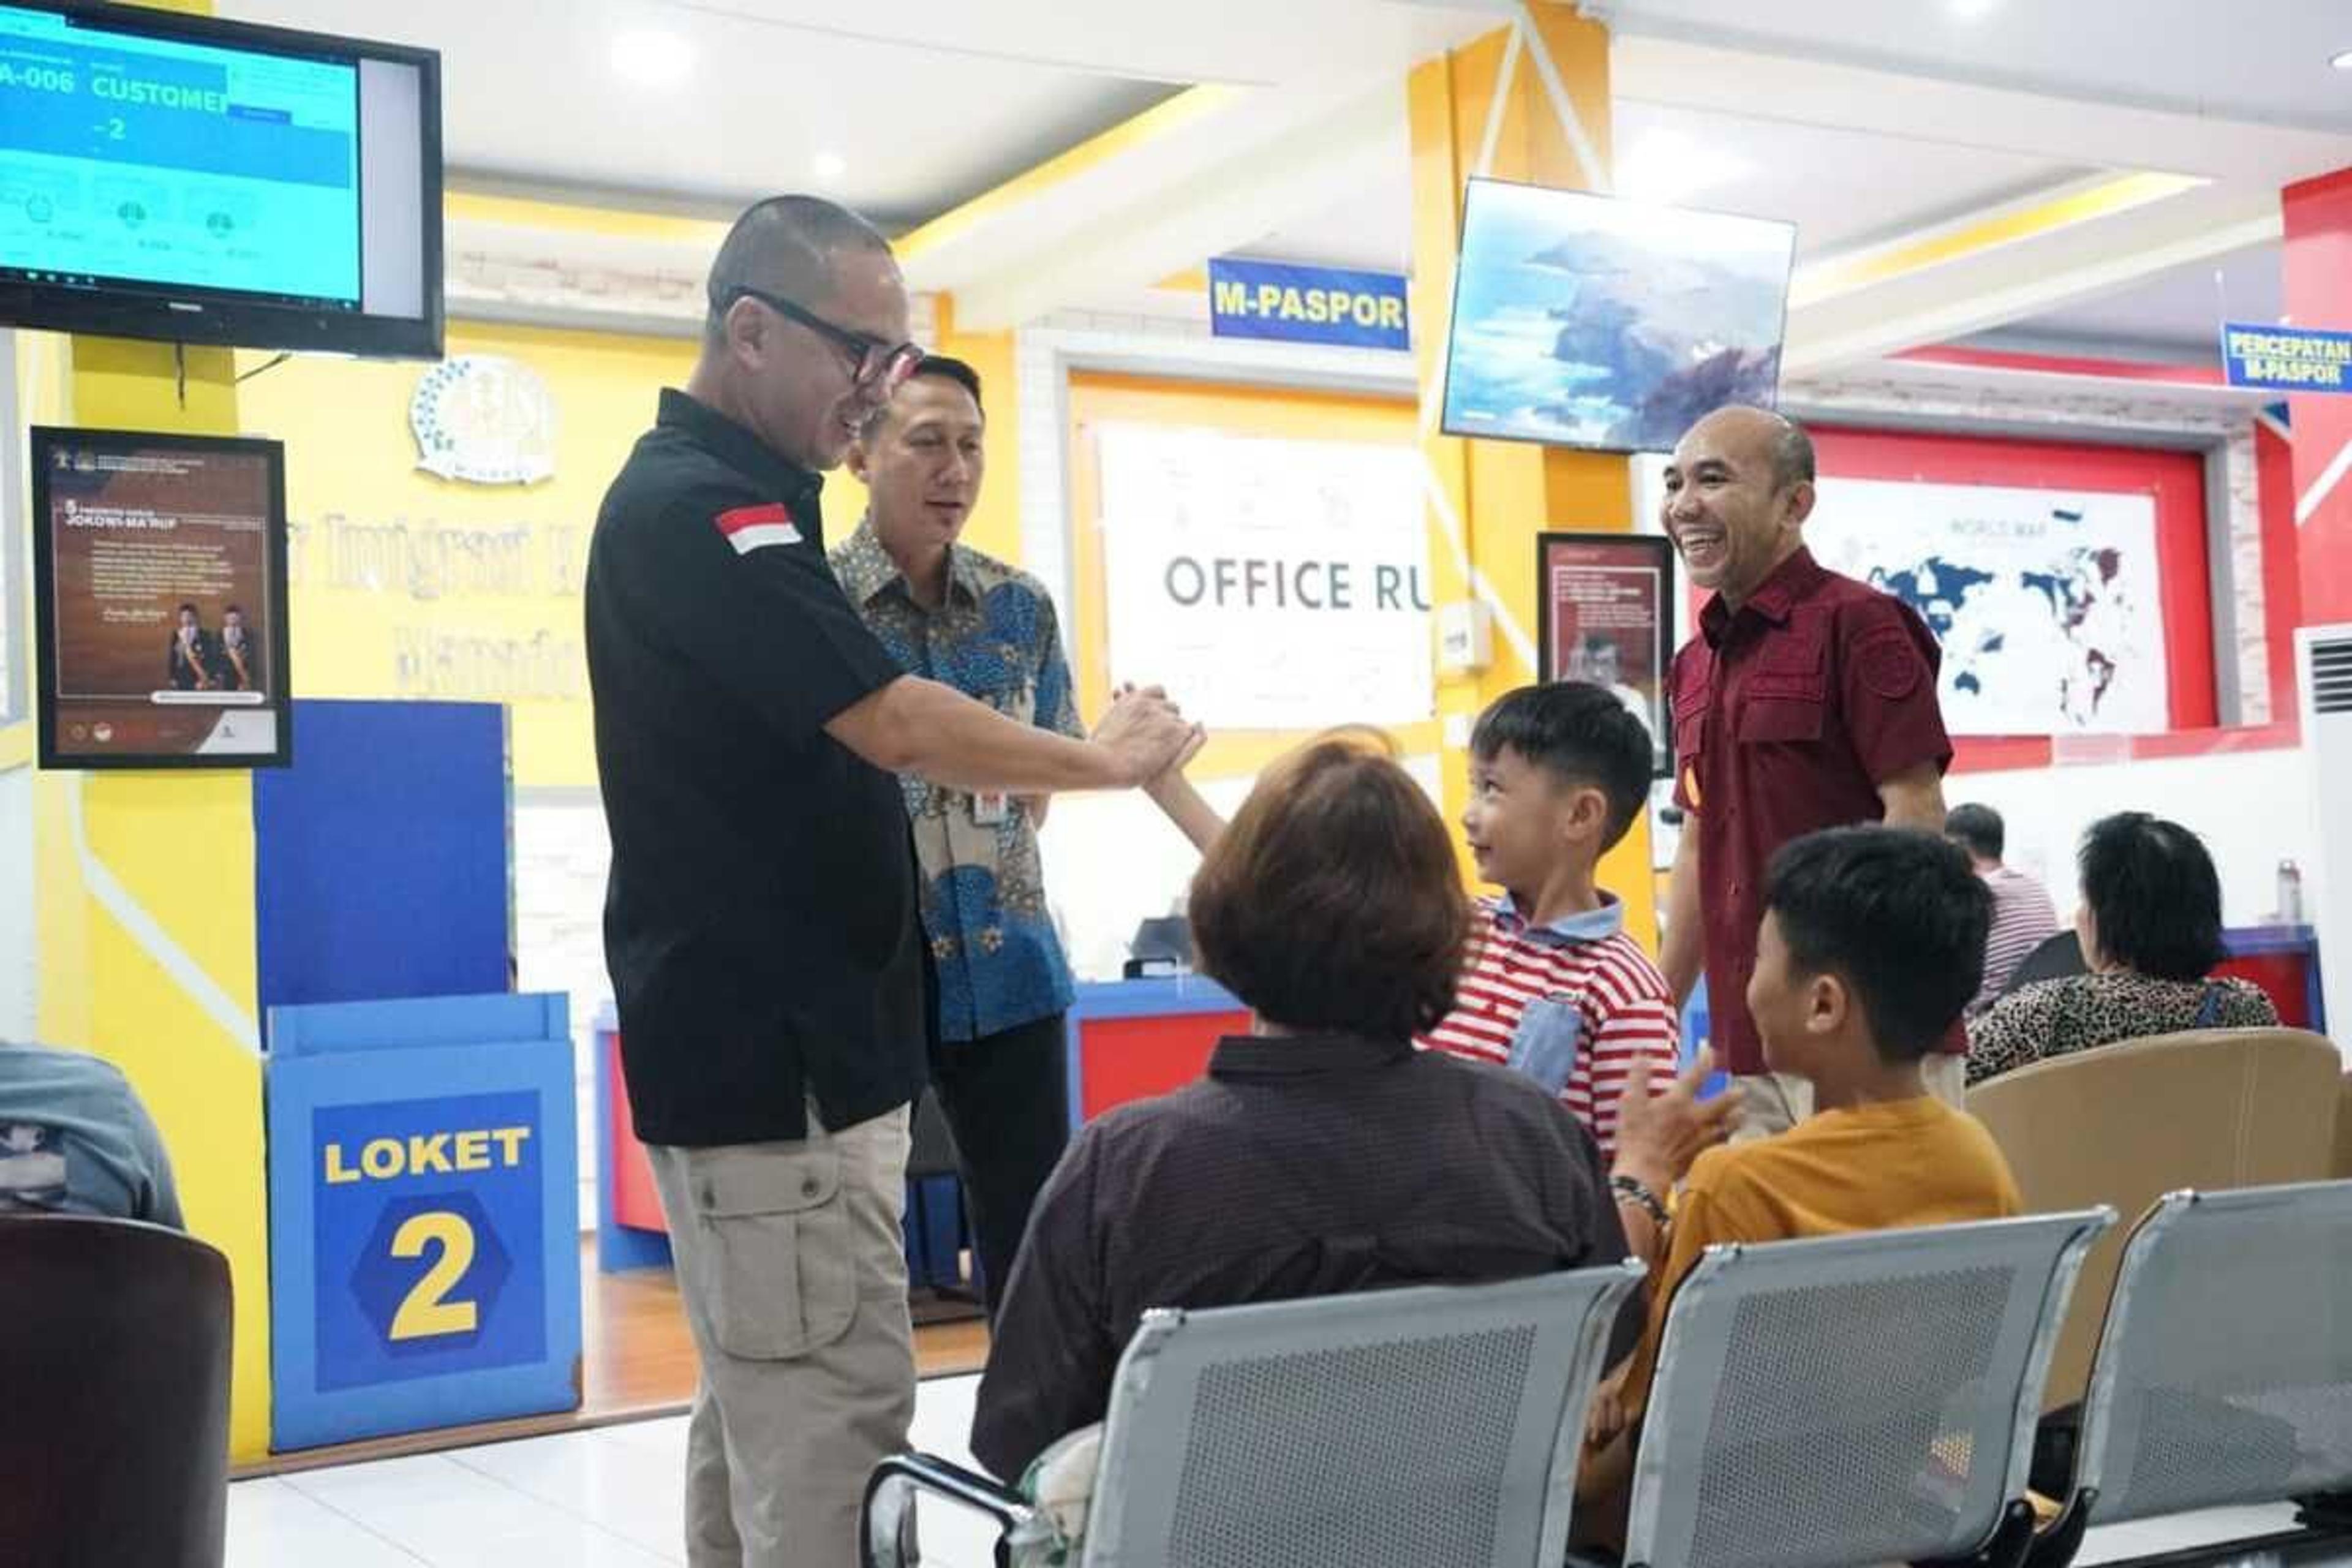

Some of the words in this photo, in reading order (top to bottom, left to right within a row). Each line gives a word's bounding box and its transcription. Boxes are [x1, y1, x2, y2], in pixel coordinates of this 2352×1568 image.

[1215, 282, 1404, 328] M-PASPOR
[1164, 557, 1350, 610] OFFICE
[325, 1127, 530, 1184] LOKET
[388, 1211, 477, 1340] 2
